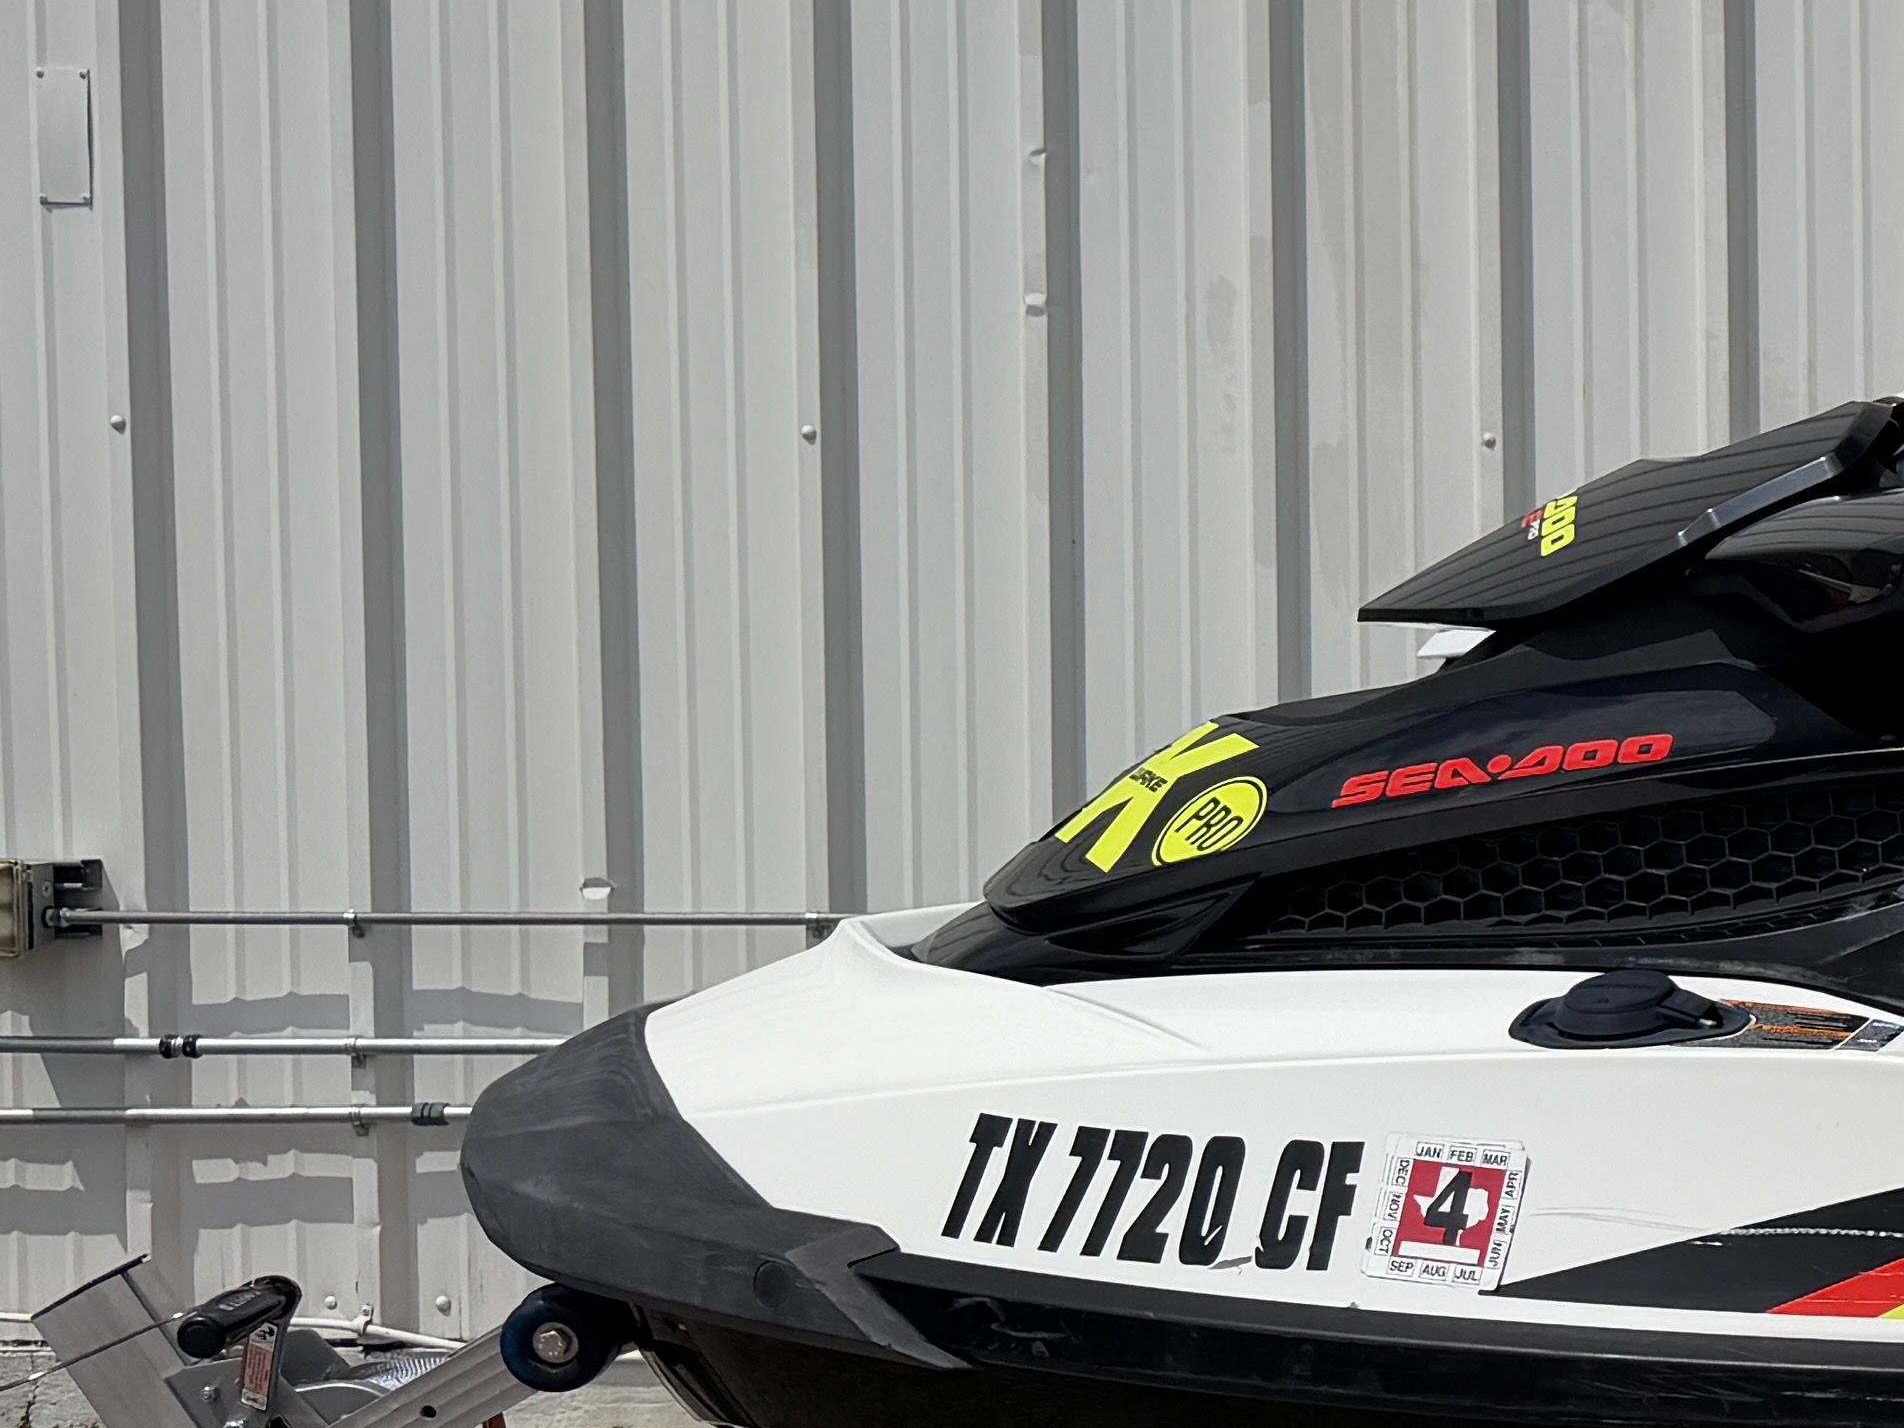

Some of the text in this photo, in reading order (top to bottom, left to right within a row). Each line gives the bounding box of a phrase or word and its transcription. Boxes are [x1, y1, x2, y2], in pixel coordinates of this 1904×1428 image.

[1174, 796, 1244, 852] PRO
[1416, 1145, 1508, 1166] JAN FEB MAR
[1395, 1159, 1409, 1186] DEC
[1503, 1171, 1518, 1199] APR
[941, 1113, 1365, 1272] TX 7720 CF
[1424, 1171, 1472, 1246] 4
[1495, 1207, 1512, 1235] MAY
[1378, 1228, 1395, 1255] OCT
[1389, 1260, 1478, 1281] SEP AUG JUL
